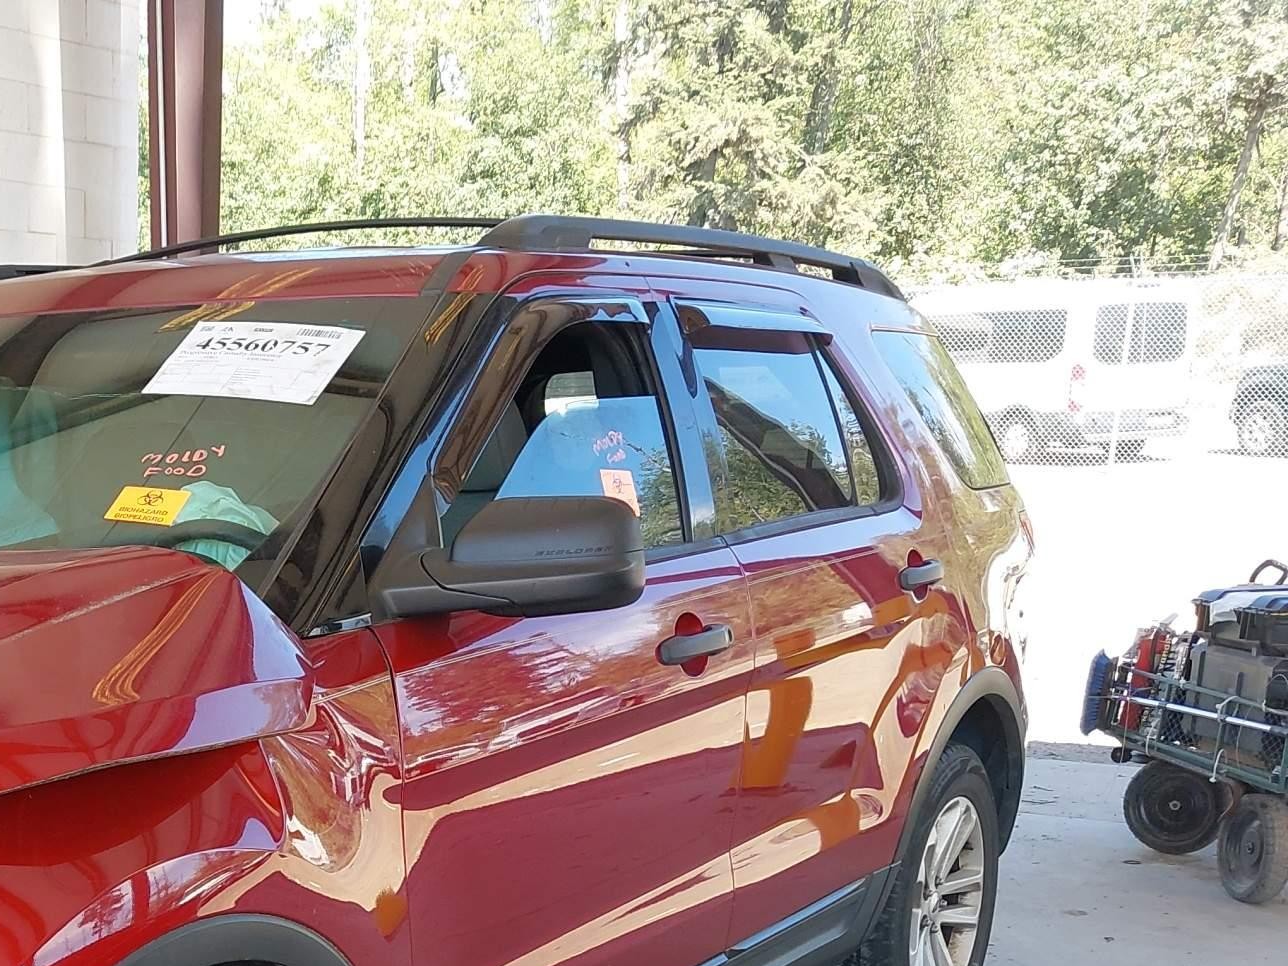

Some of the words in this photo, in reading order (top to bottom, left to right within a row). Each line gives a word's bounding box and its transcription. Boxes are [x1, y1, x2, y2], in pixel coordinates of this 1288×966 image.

[196, 337, 331, 357] 45560757
[142, 445, 225, 464] MOLDY
[143, 464, 207, 478] FOOD
[118, 506, 169, 516] BIOHAZARD
